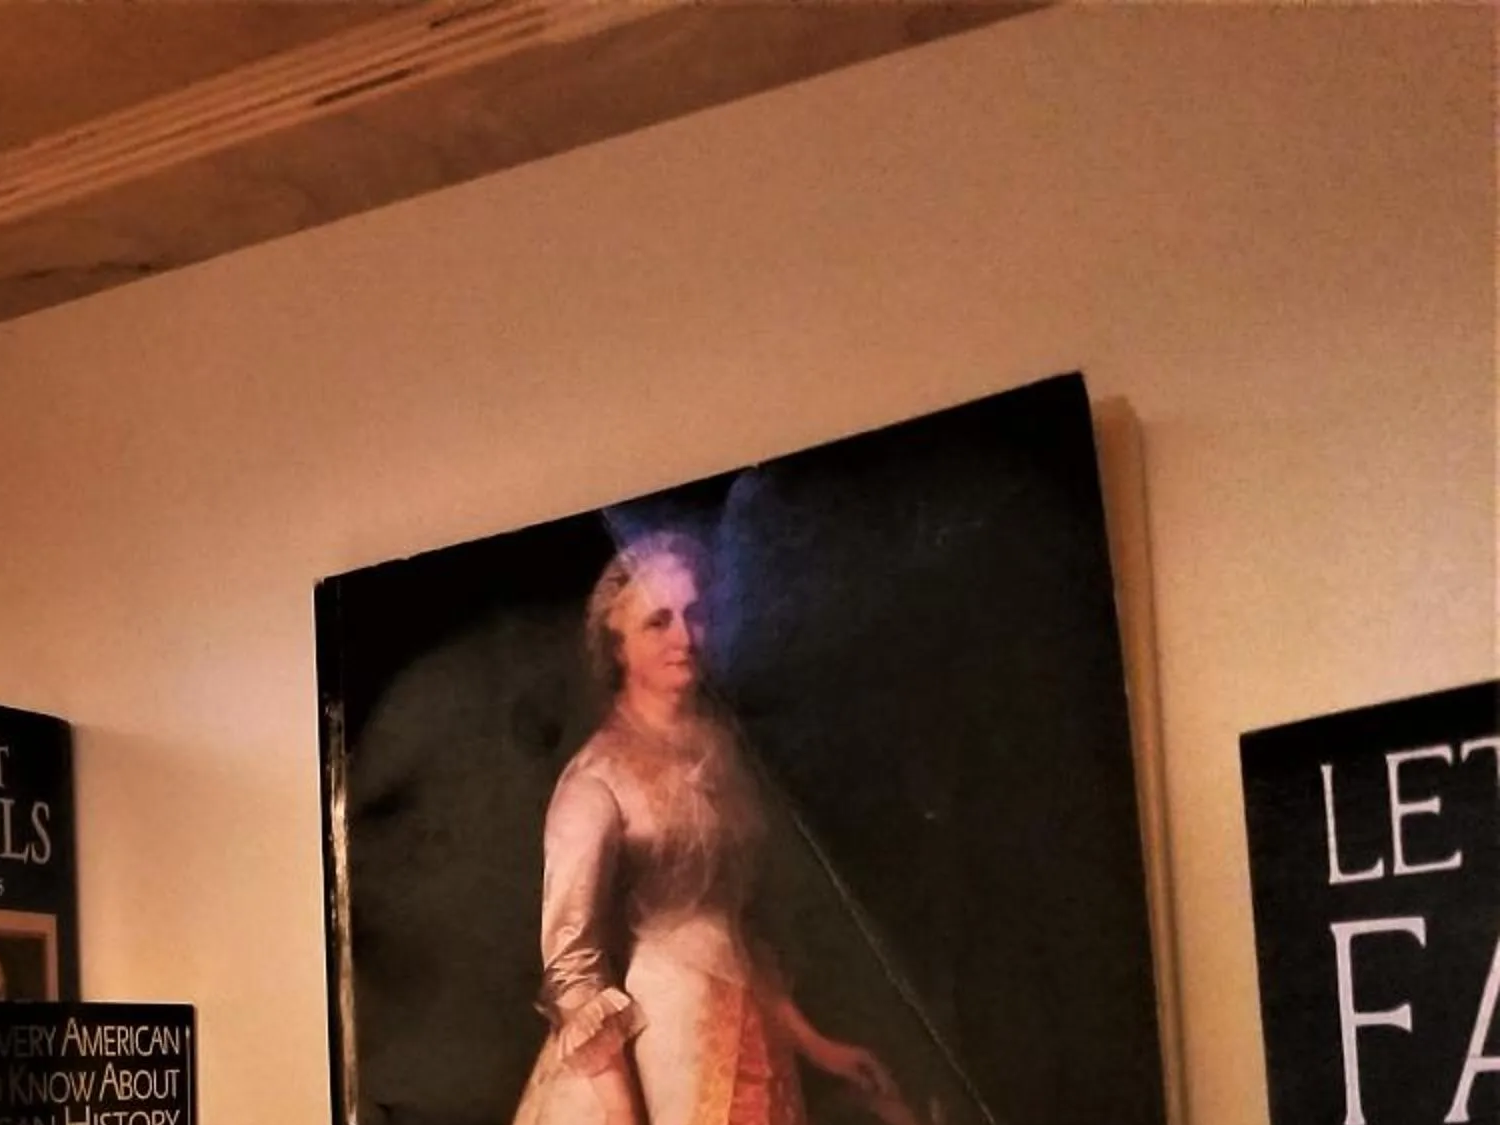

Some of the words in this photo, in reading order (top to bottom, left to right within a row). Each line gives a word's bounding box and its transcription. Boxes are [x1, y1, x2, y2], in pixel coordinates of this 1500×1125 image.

[59, 1016, 181, 1058] AMERICAN
[7, 1065, 97, 1106] KNOW
[98, 1062, 181, 1102] ABOUT
